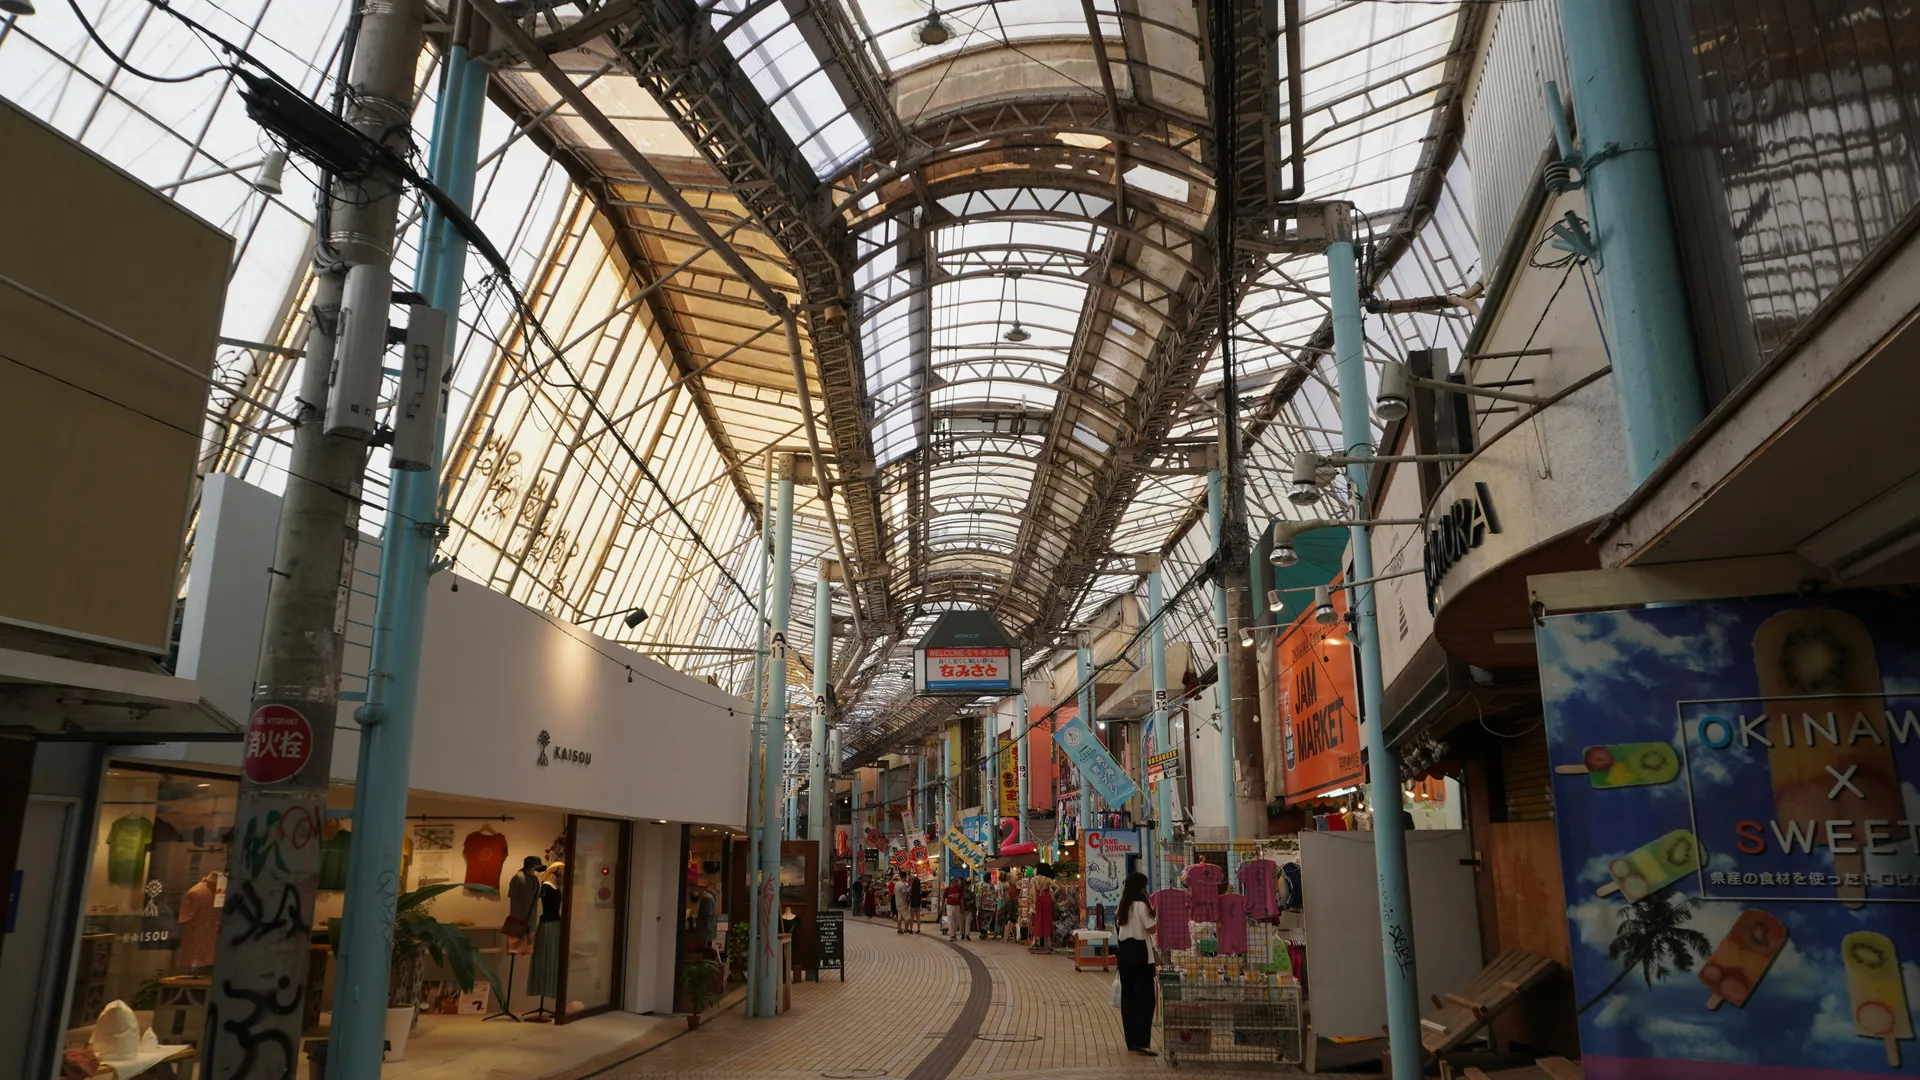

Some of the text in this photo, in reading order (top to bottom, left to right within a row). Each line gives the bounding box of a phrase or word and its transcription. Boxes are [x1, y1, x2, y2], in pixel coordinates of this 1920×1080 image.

[771, 632, 786, 645] A
[1216, 626, 1228, 638] B
[771, 646, 785, 659] 11
[939, 664, 998, 677] なみさと
[1156, 690, 1167, 700] B
[1294, 661, 1318, 716] JAM
[815, 695, 826, 705] A
[815, 706, 826, 716] 12
[267, 717, 299, 726] HYDRANT
[1296, 696, 1345, 763] MARKET
[246, 730, 304, 758] 消火栓
[553, 745, 593, 765] KAISOU
[1147, 750, 1178, 766] VACANCES
[1088, 832, 1118, 849] CRANE
[1105, 844, 1132, 853] JUNGLE
[122, 930, 169, 943] KAISOU
